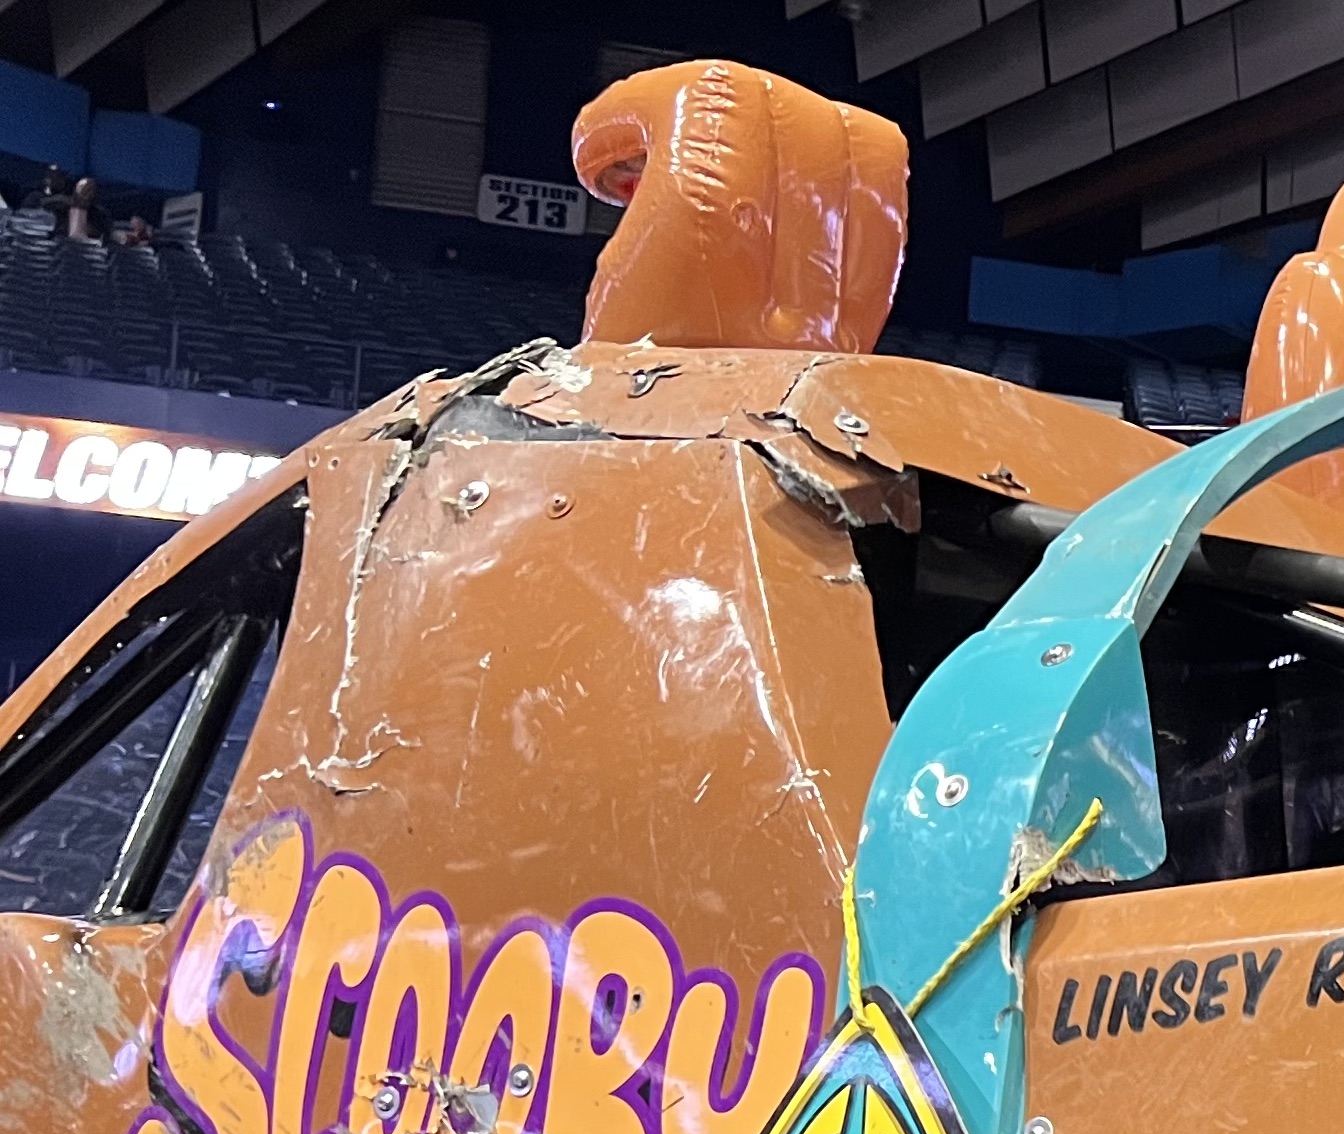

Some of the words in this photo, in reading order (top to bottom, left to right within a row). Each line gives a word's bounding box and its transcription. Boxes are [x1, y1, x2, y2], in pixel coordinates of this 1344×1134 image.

[488, 178, 578, 203] SECTION
[495, 193, 568, 229] 213
[1052, 947, 1283, 1045] LINSEY
